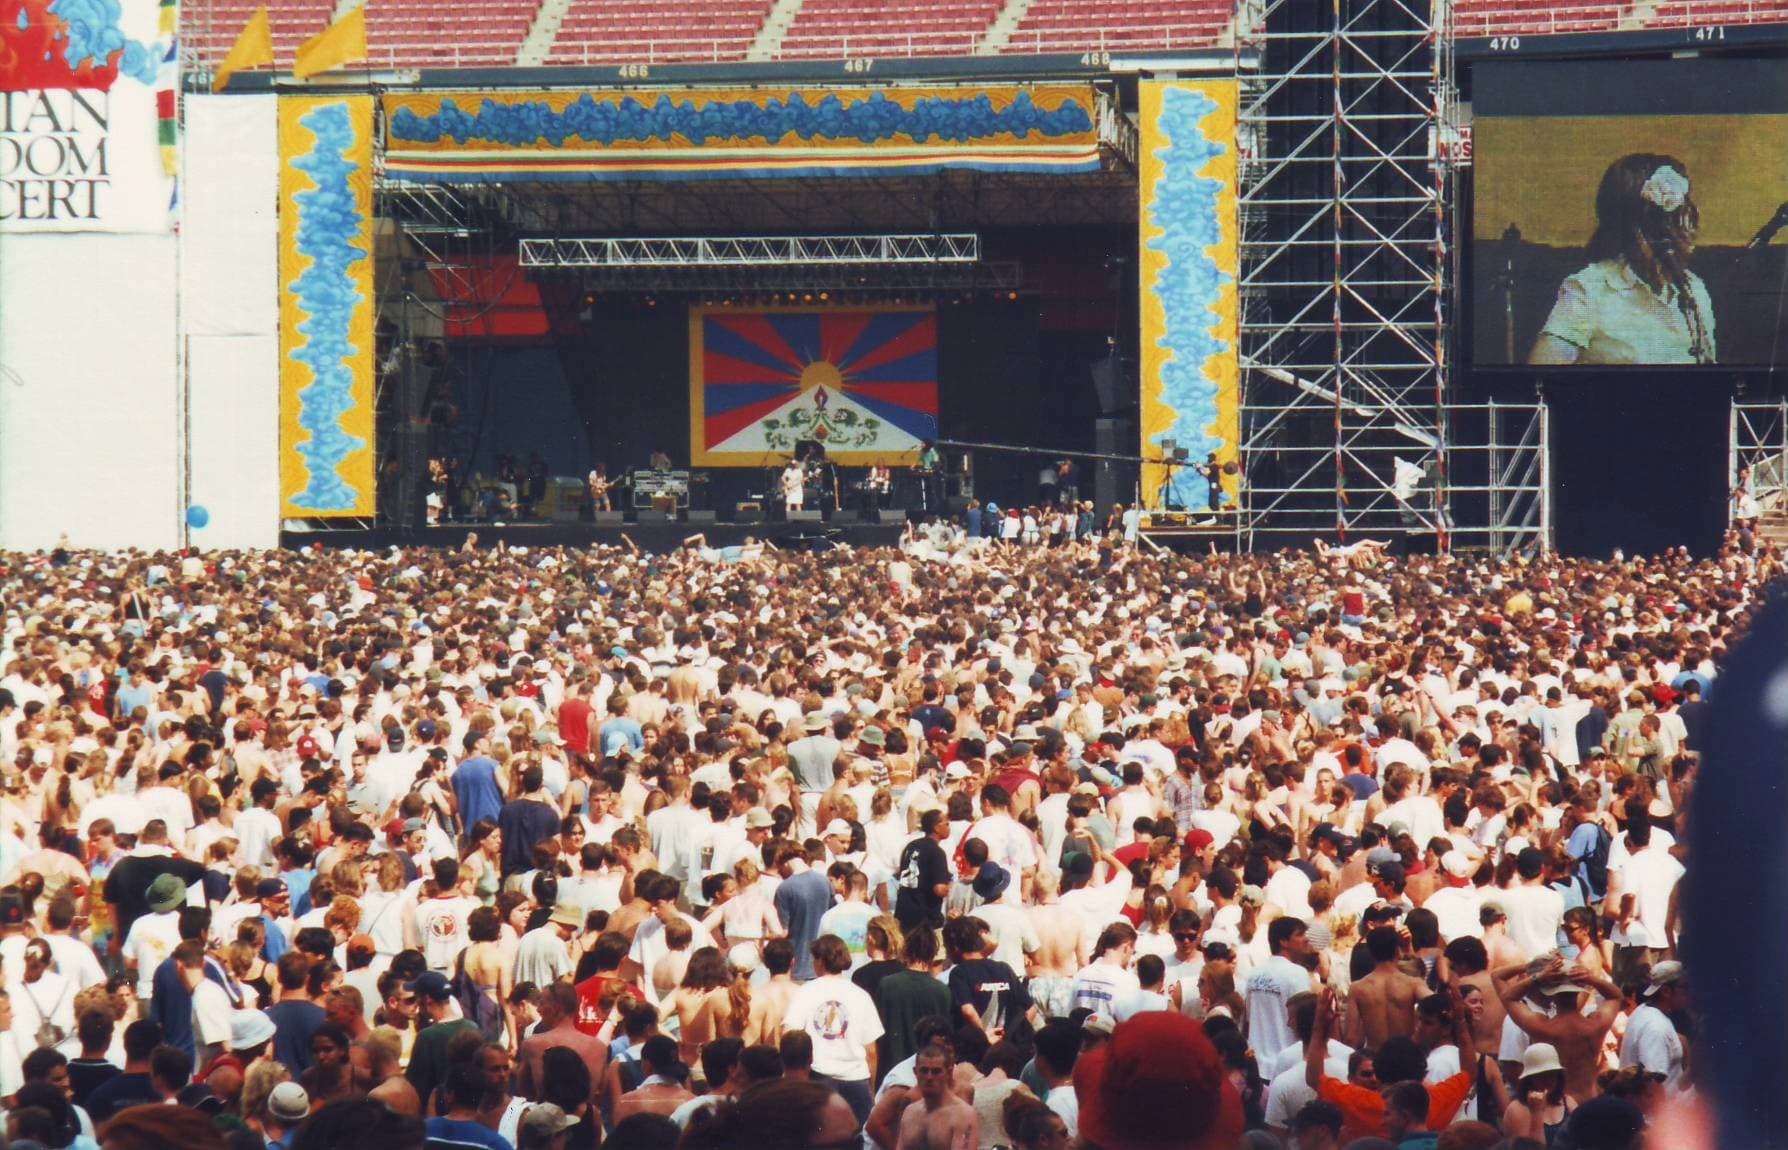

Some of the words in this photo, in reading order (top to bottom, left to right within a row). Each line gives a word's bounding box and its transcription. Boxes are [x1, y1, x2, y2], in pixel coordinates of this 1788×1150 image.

[1696, 26, 1725, 41] 471
[1490, 36, 1520, 51] 470
[844, 58, 873, 72] 467
[1080, 52, 1110, 66] 468
[618, 64, 648, 78] 466
